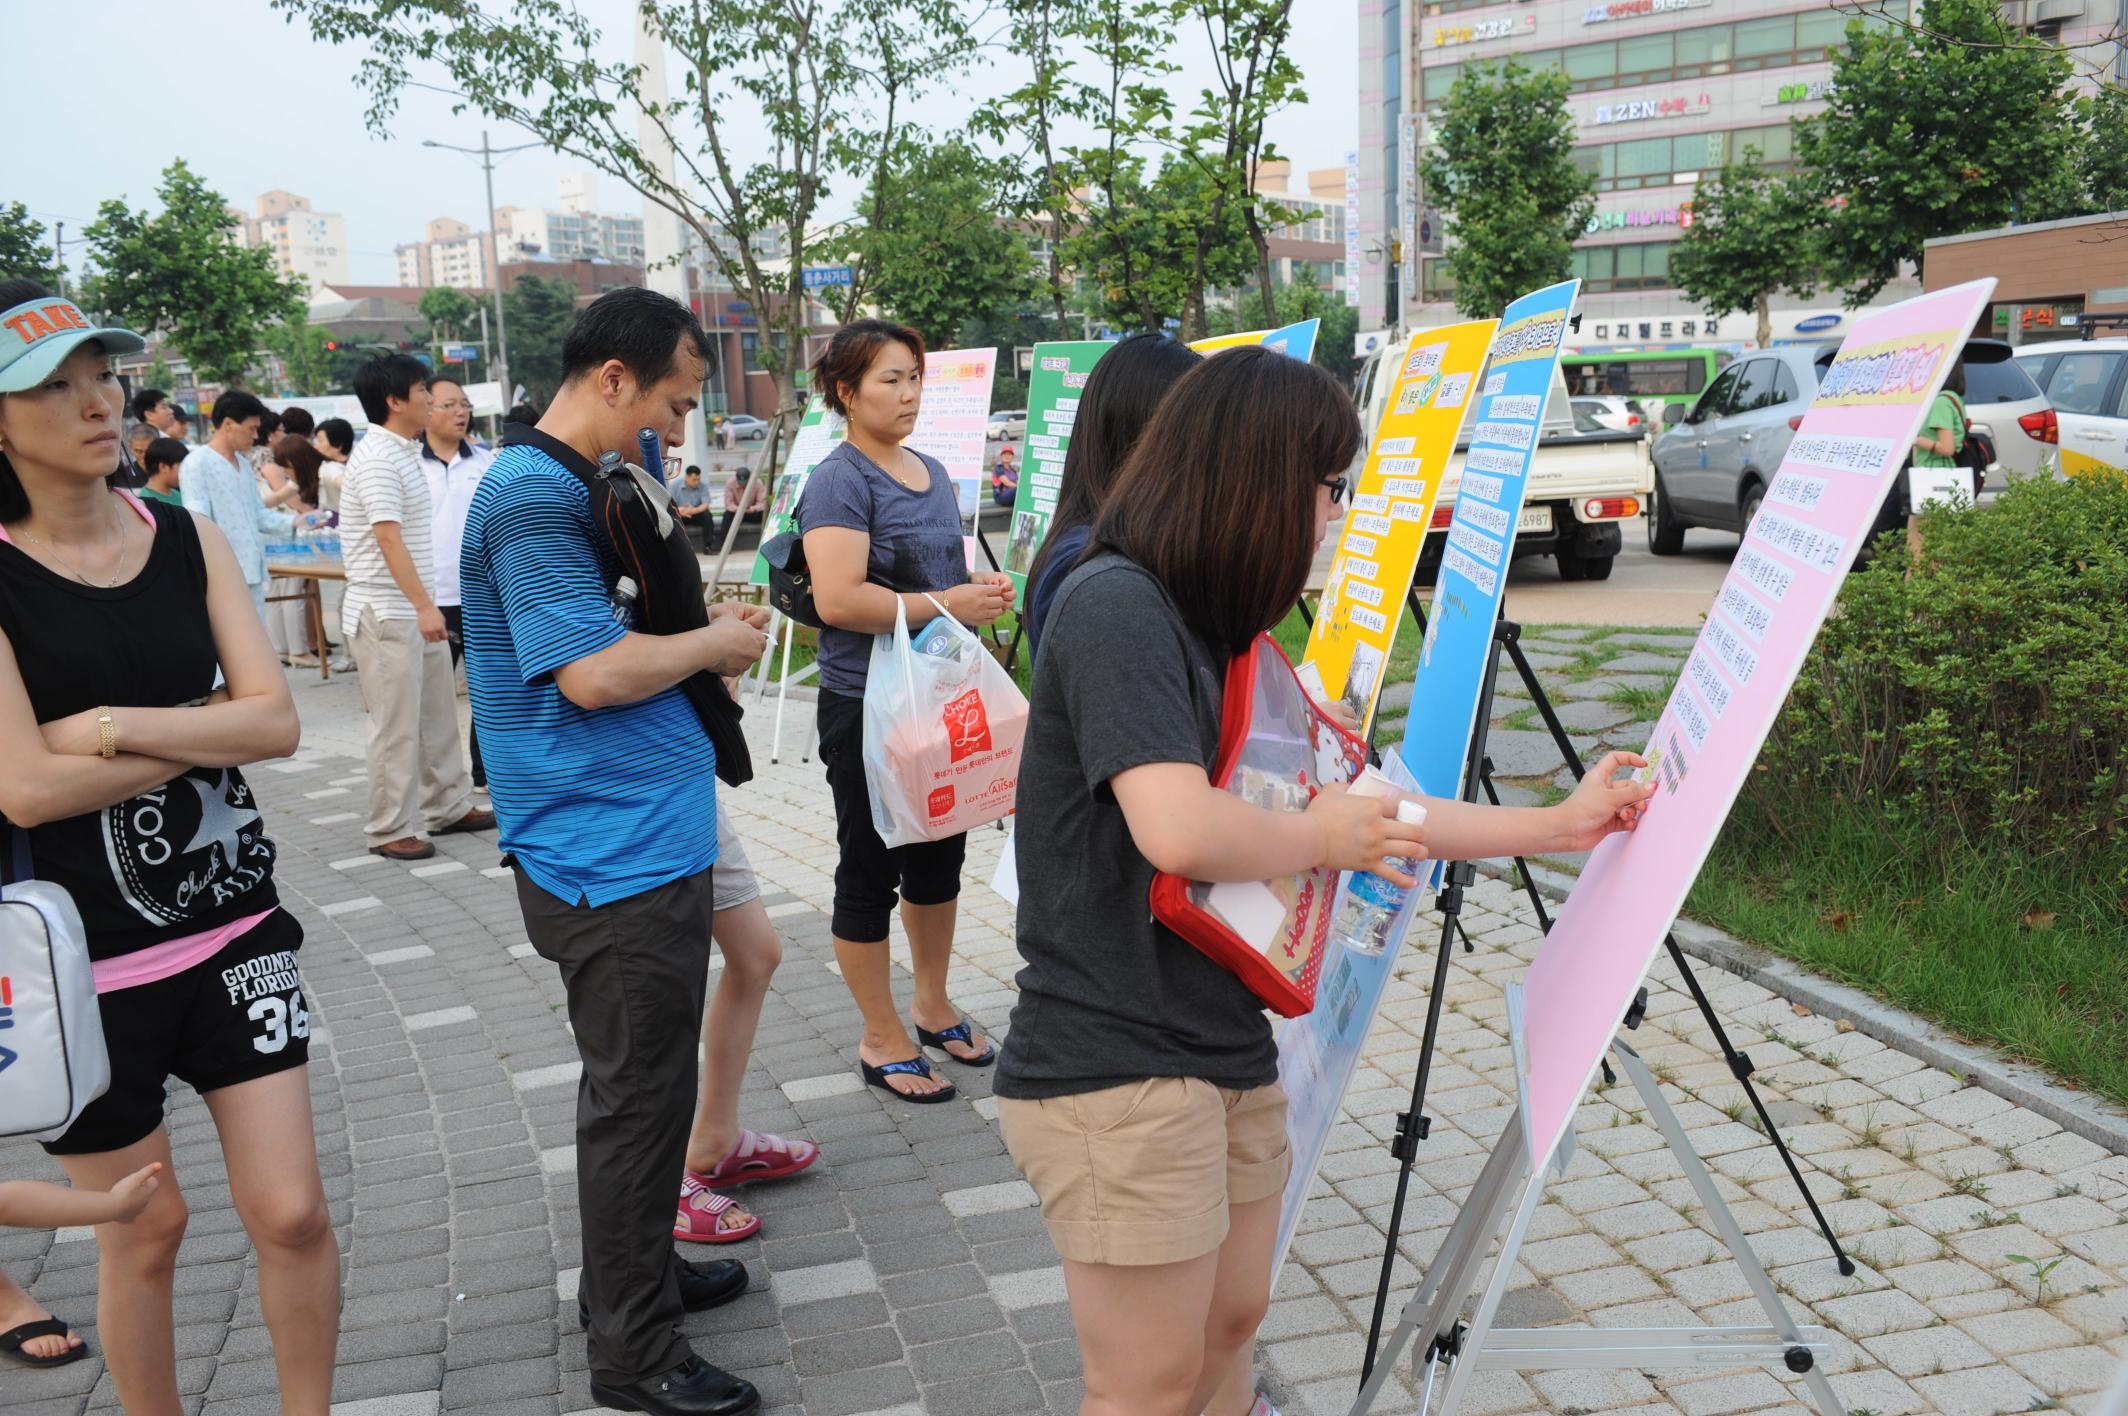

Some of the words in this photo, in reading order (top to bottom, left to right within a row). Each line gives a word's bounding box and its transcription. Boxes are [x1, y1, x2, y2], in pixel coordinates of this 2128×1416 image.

[1616, 100, 1656, 122] ZEN
[4, 304, 89, 345] TAKE
[1595, 320, 1720, 342] 디지털프라자
[1798, 316, 1840, 331] SAMSUNG
[1523, 513, 1549, 527] 6987
[177, 845, 221, 908] Chuck
